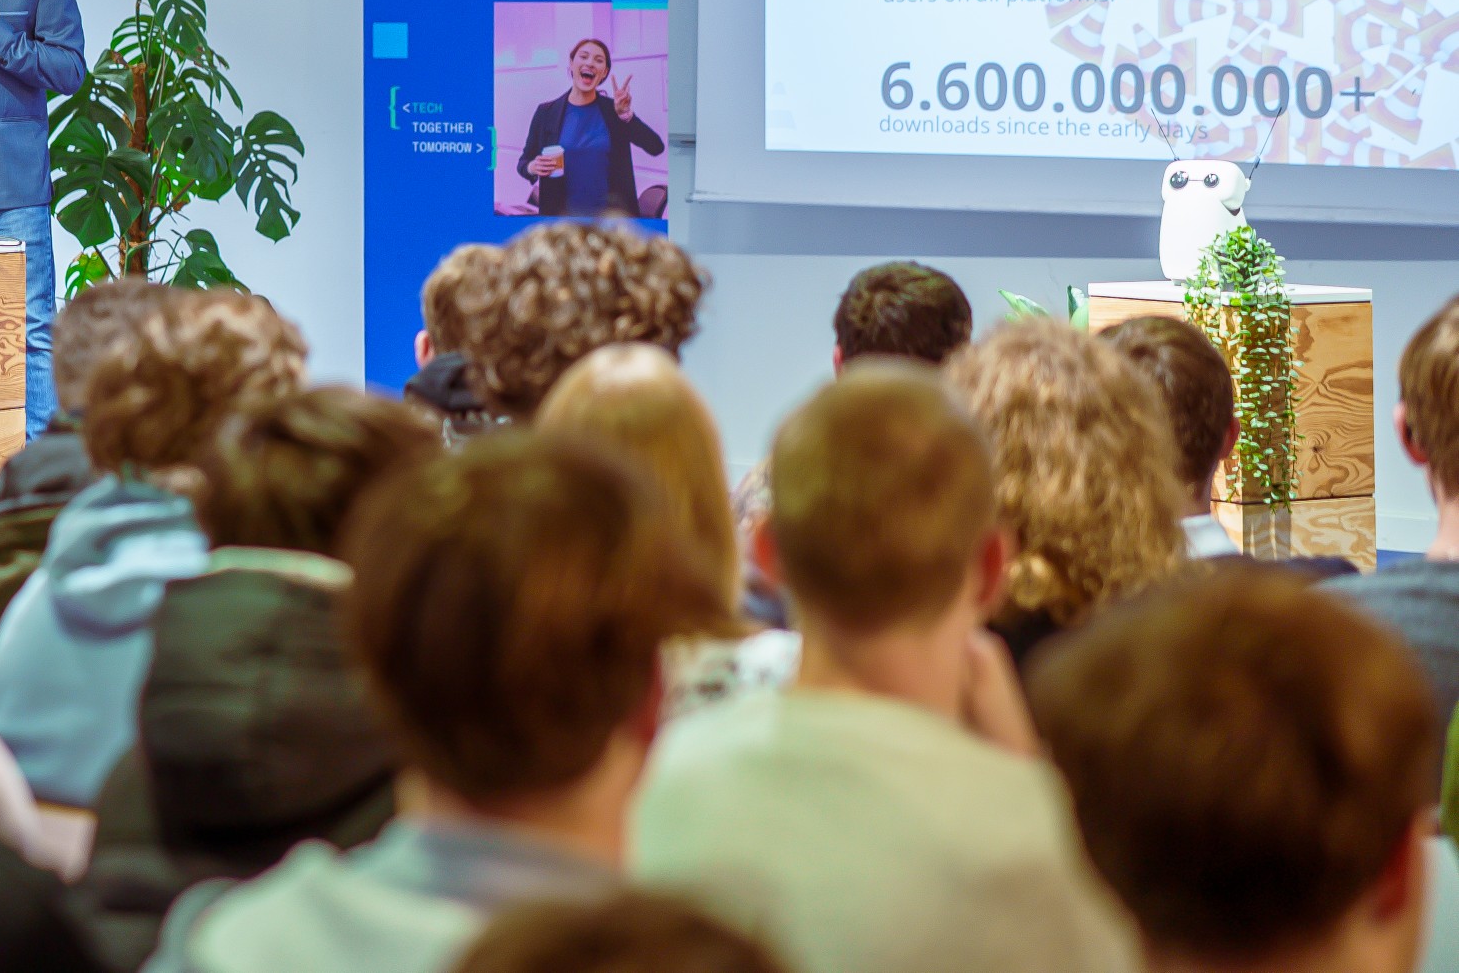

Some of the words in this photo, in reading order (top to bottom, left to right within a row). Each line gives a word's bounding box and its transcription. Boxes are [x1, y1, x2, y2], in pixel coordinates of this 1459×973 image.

[412, 121, 474, 134] TOGETHER
[878, 113, 990, 137] downloads
[995, 114, 1051, 137] since
[1056, 115, 1090, 138] the
[1097, 116, 1151, 143] early
[1157, 119, 1208, 145] days
[412, 141, 473, 154] TOMORROW
